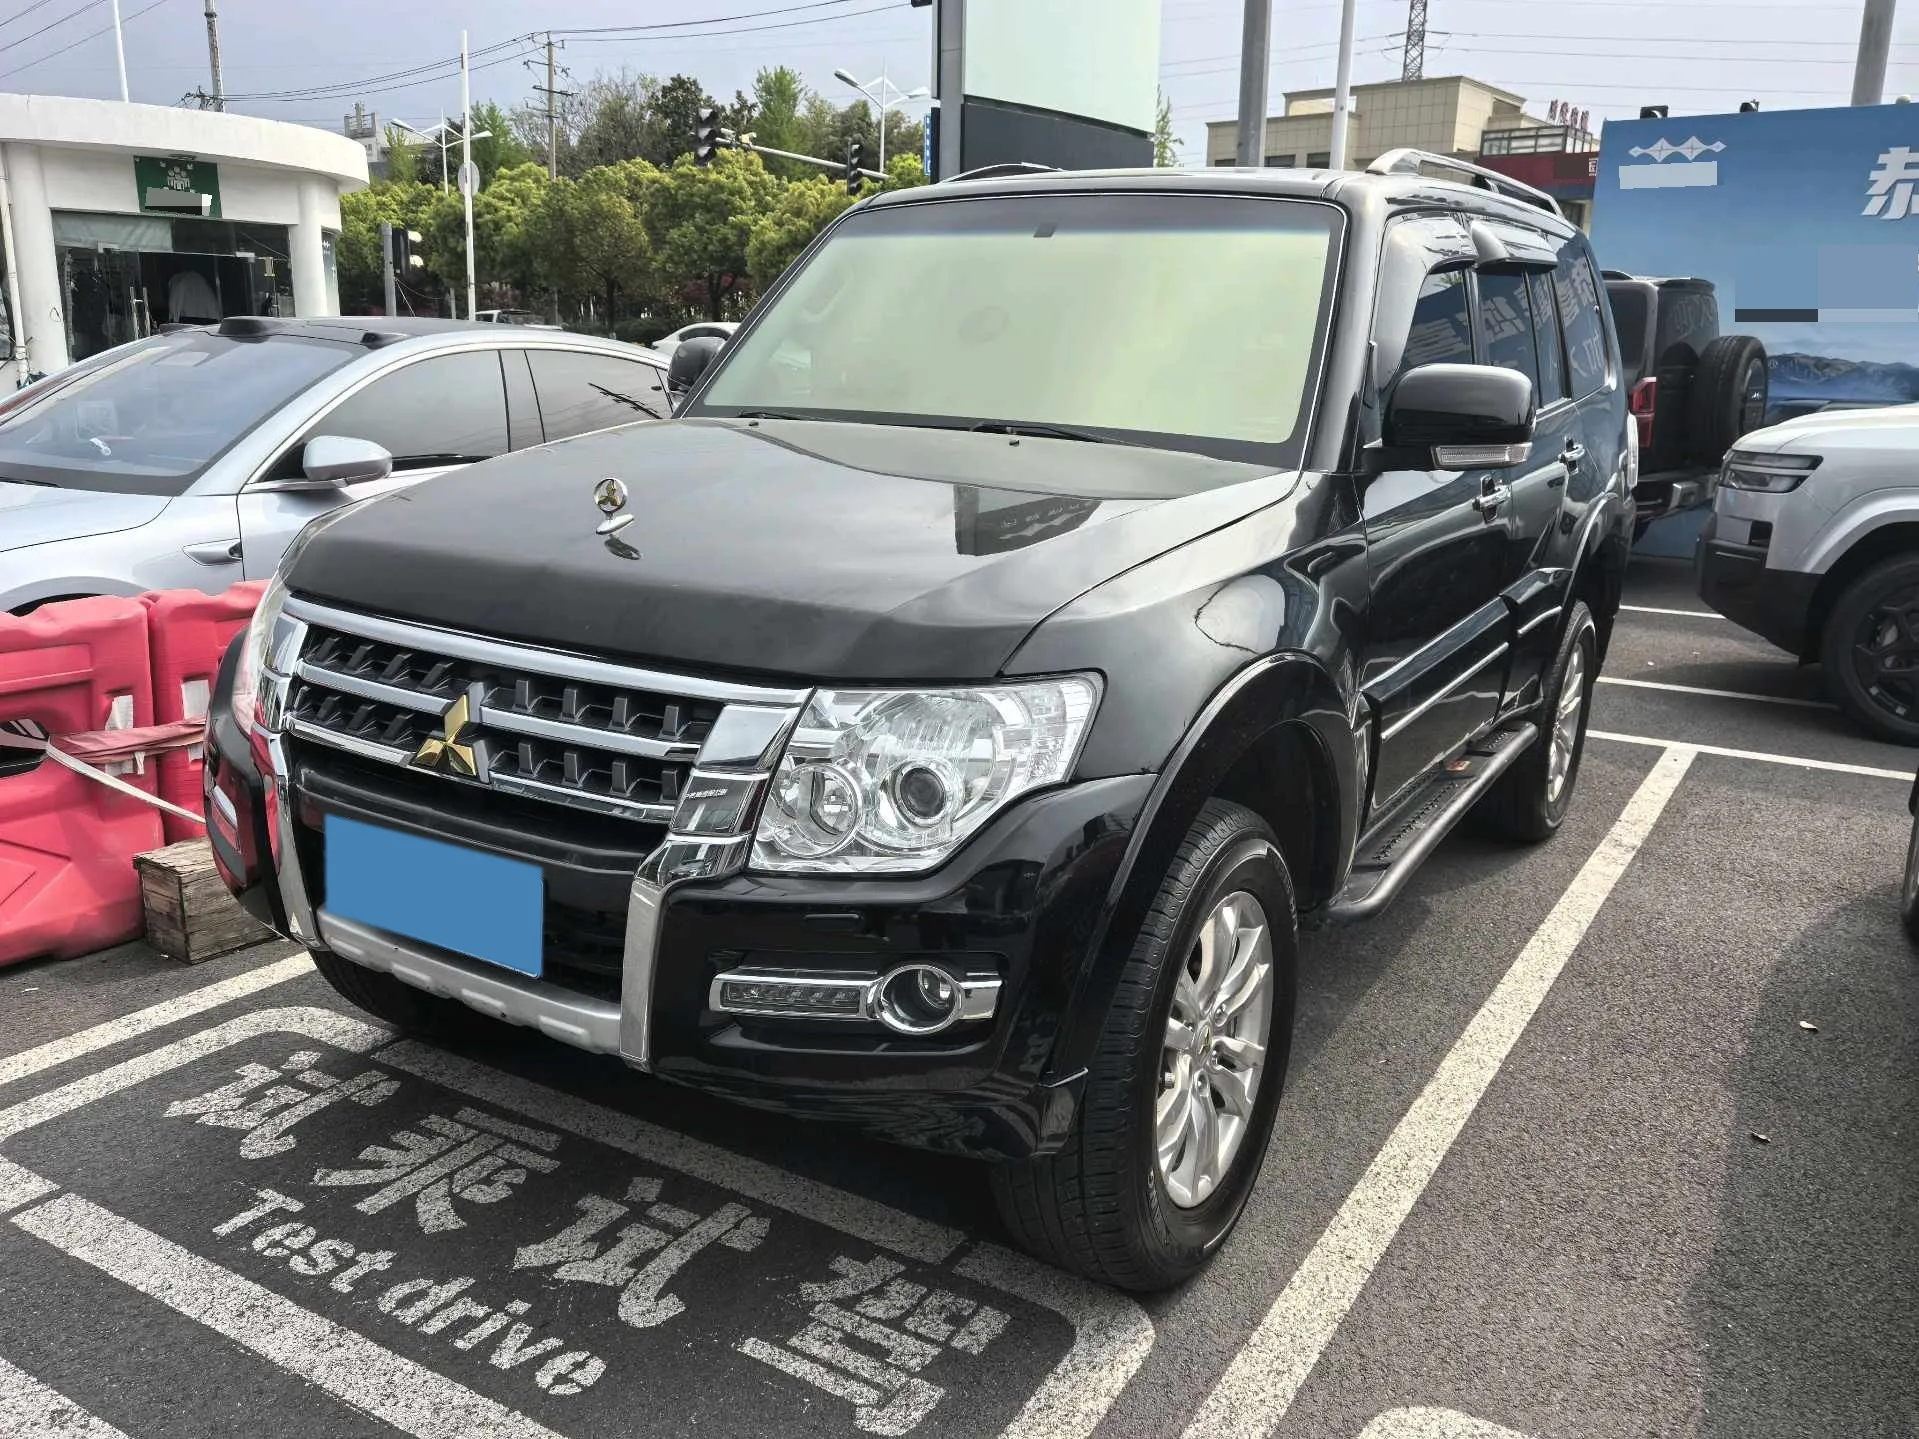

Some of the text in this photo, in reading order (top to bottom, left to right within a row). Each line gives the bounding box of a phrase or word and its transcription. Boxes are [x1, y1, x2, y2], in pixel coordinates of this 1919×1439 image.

[162, 1050, 1012, 1437] 试乘试驾
[212, 1188, 608, 1395] Test drive
